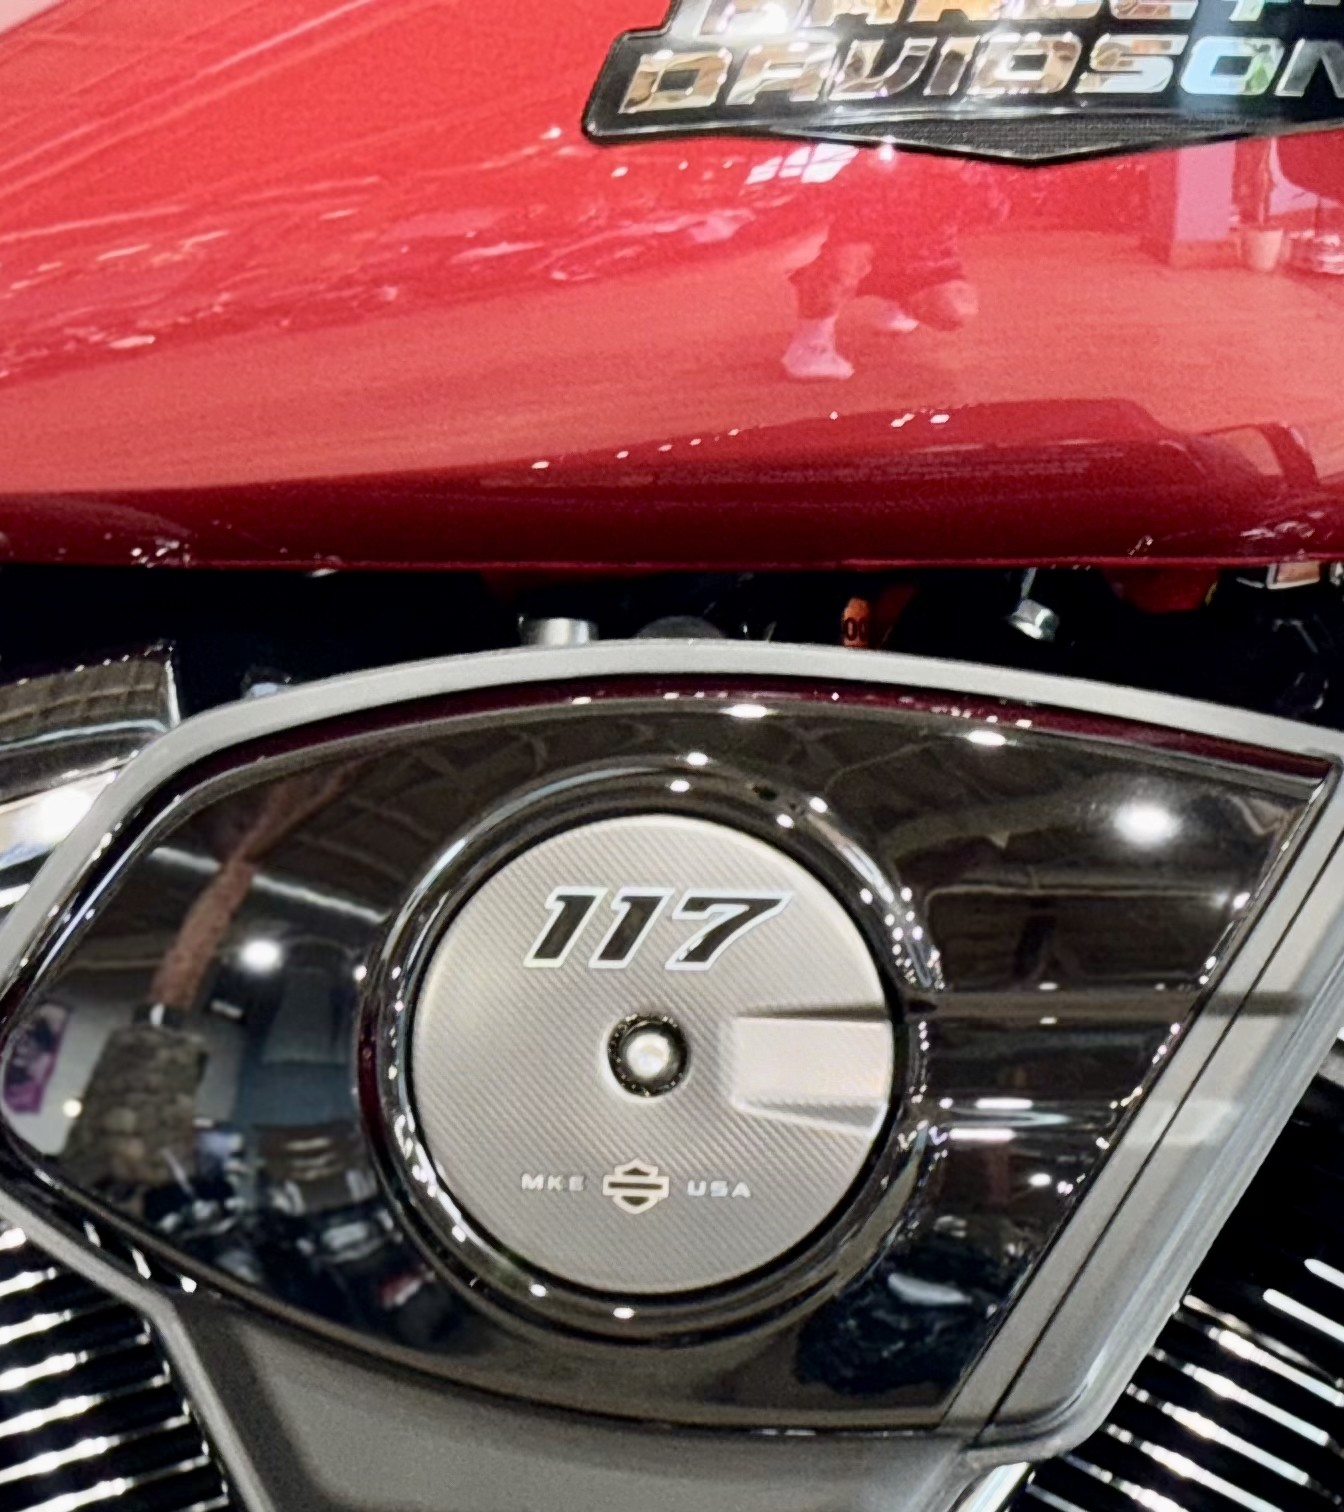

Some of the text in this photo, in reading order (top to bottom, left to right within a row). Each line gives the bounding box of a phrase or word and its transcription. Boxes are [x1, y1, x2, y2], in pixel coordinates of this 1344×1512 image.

[524, 886, 793, 970] 117
[521, 1173, 752, 1198] MKE USA
